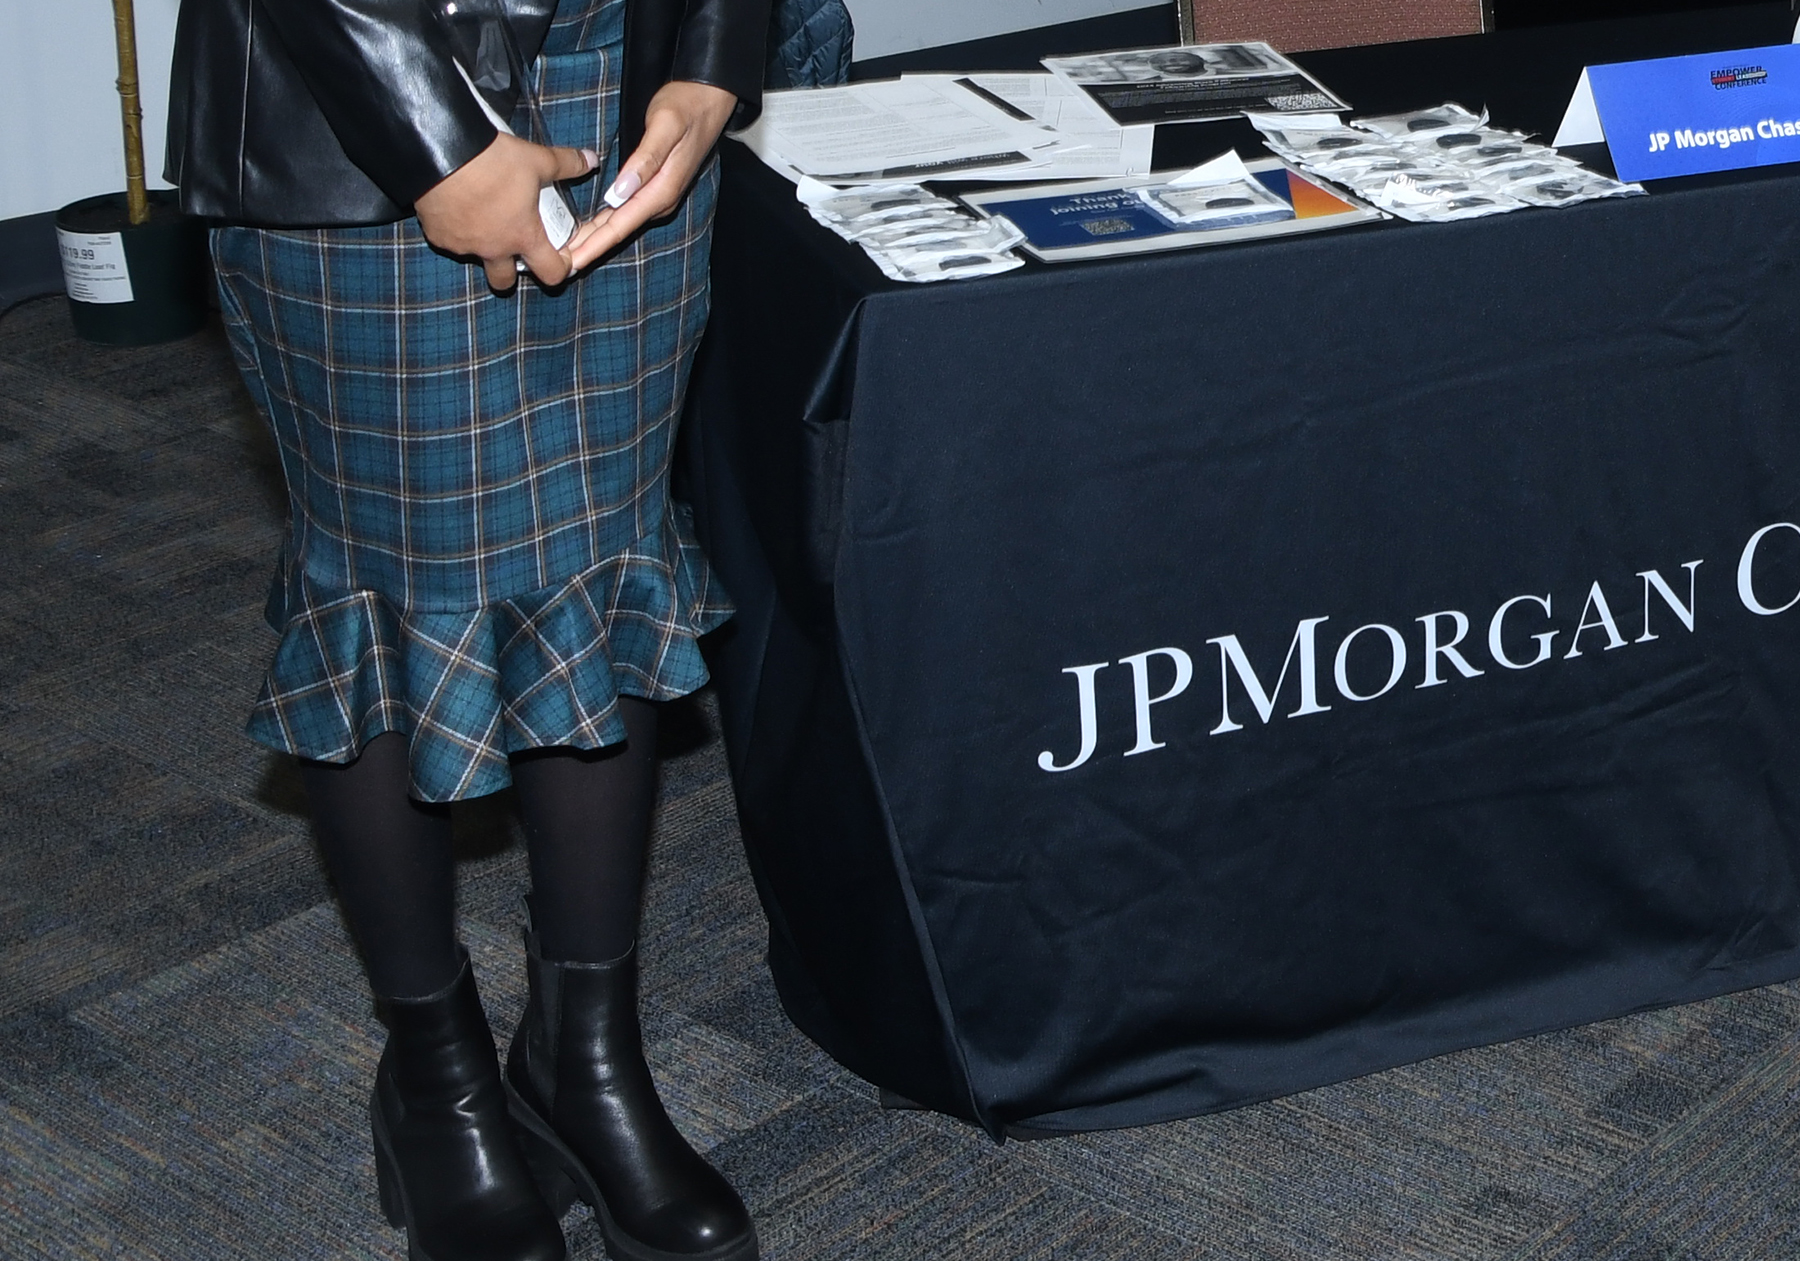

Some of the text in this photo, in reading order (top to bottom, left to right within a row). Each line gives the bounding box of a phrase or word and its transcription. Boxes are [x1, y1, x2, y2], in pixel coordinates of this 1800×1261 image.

[1711, 66, 1763, 79] EMPOWER
[1715, 77, 1767, 90] CONFERENCE
[1649, 132, 1670, 153] JP
[1673, 126, 1755, 149] Morgan
[1070, 193, 1130, 204] Thank
[1050, 200, 1118, 216] joining
[1037, 559, 1698, 773] JPMORGAN
